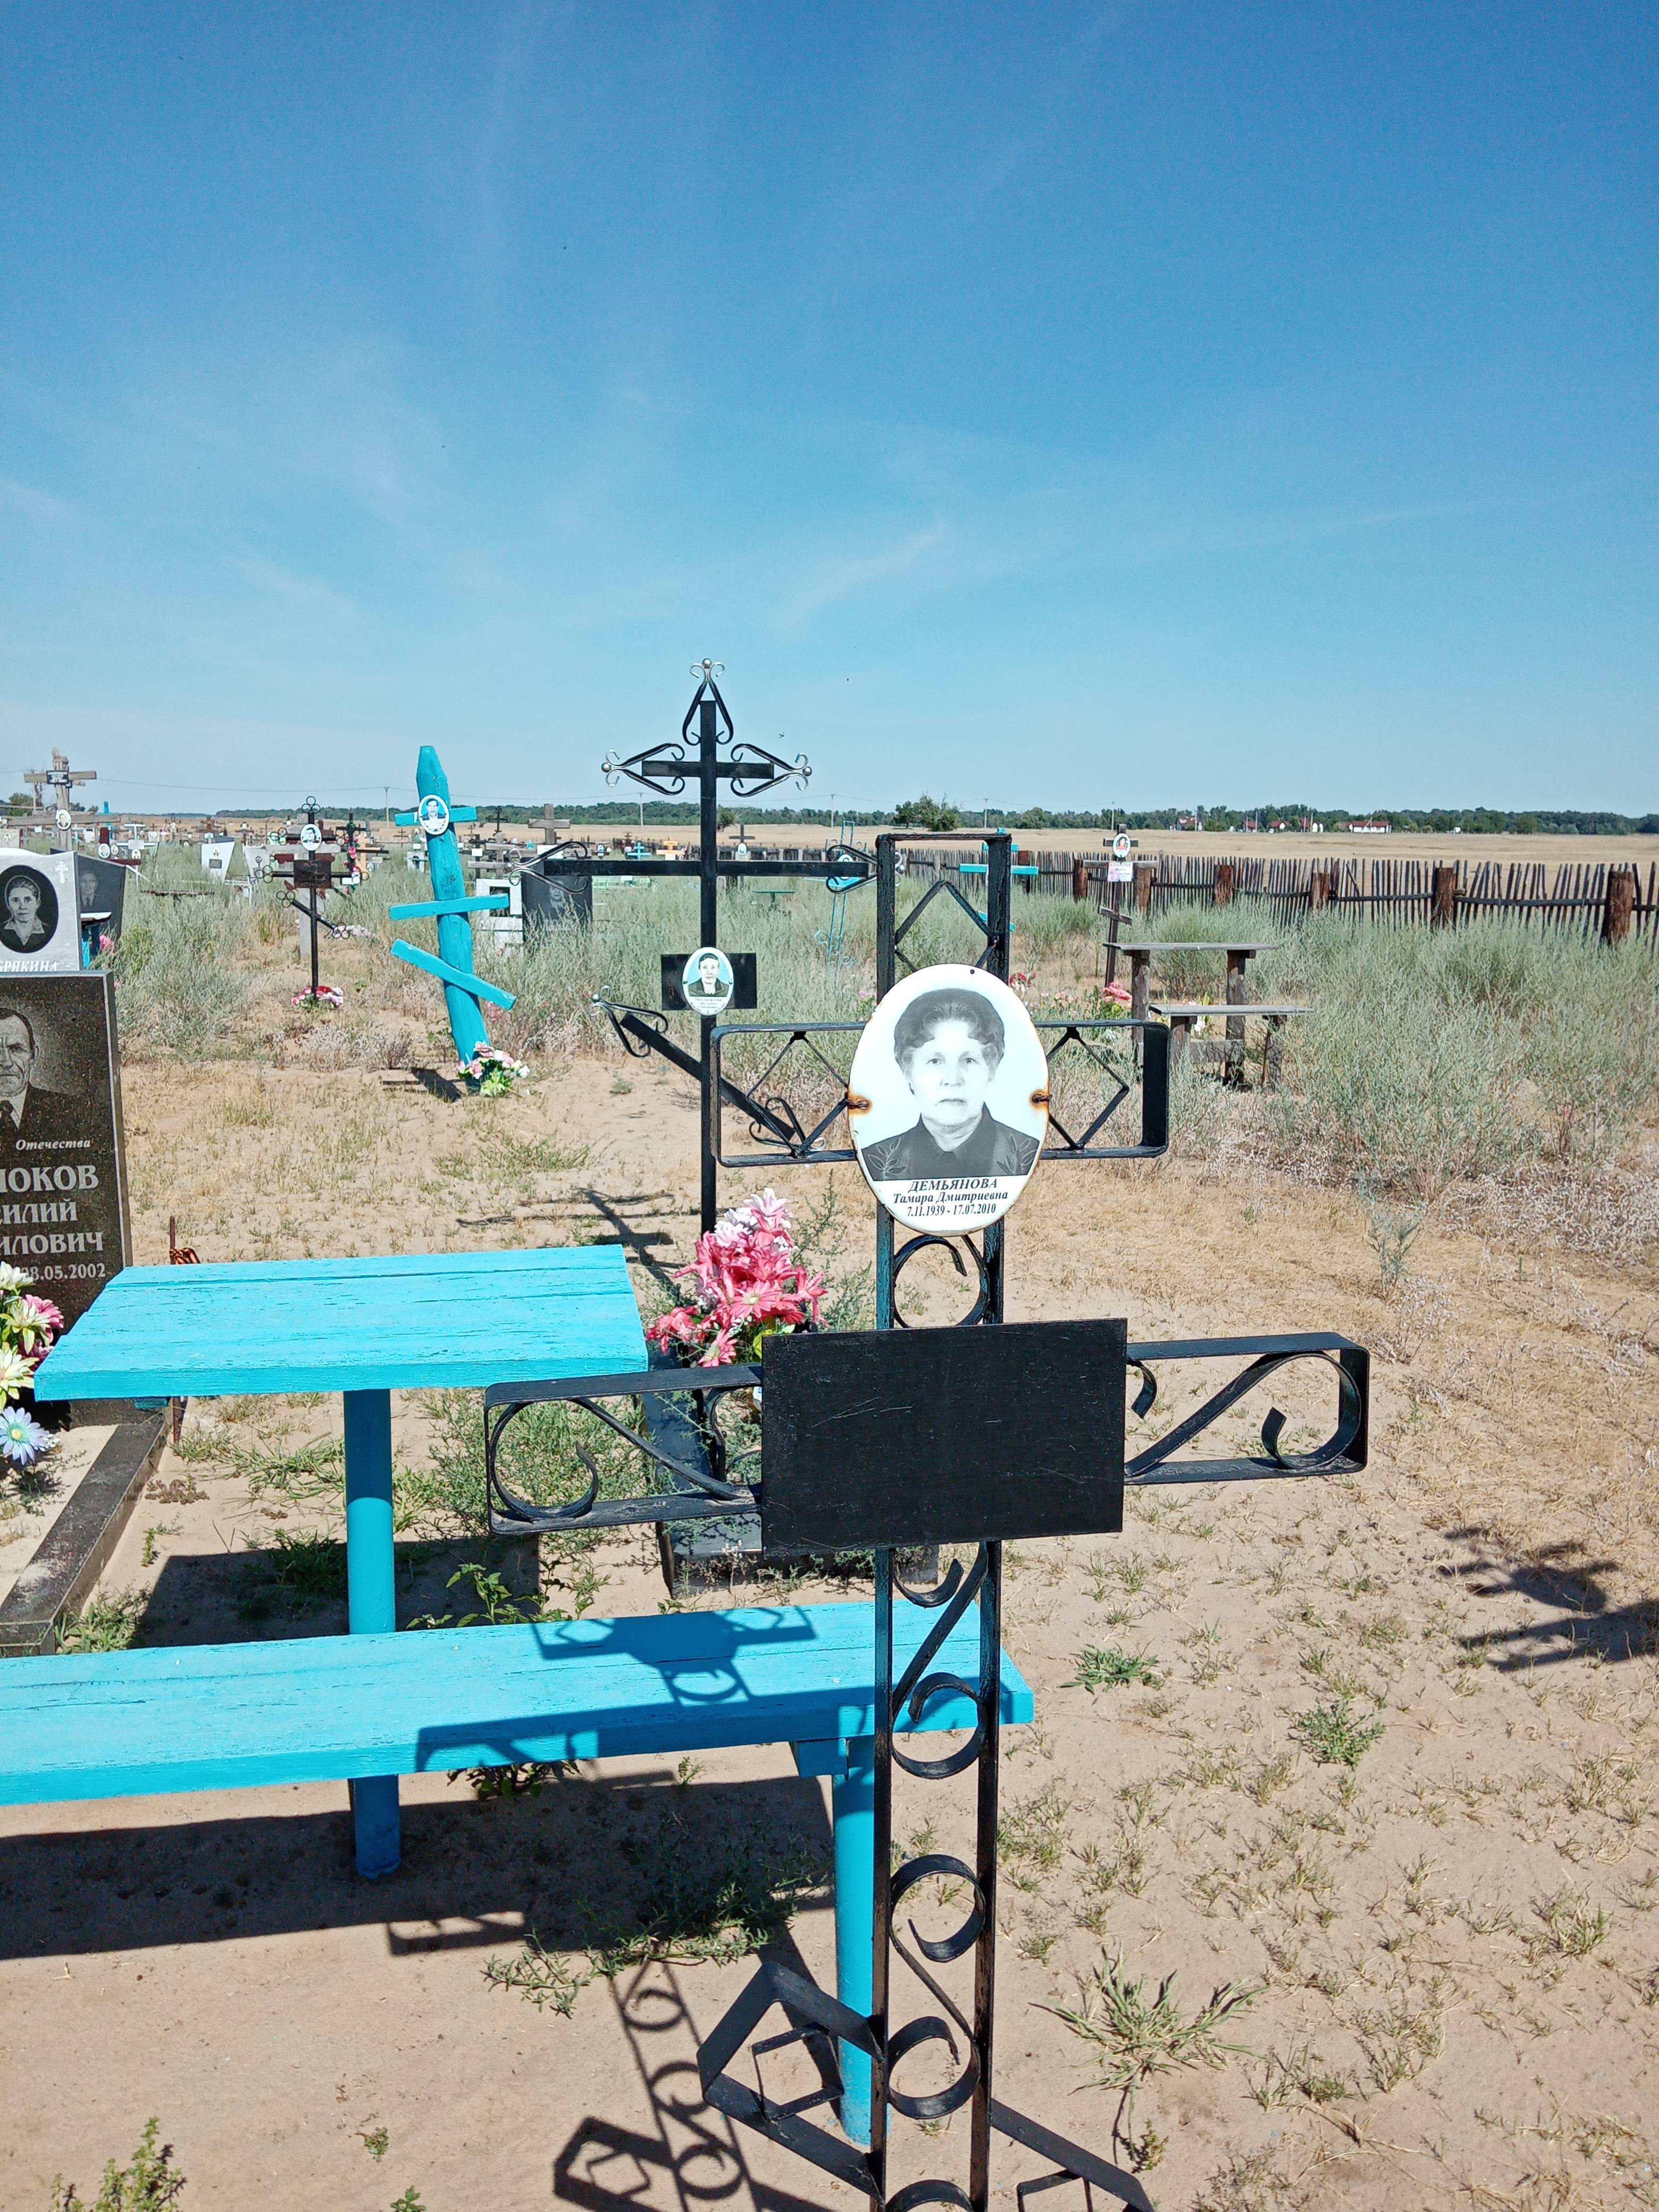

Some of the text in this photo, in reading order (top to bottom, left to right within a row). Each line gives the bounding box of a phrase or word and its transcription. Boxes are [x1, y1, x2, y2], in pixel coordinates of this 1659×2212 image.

[15, 1139, 91, 1150] Отечества
[908, 1178, 998, 1193] ДЕМЬЯНОВА
[893, 1191, 1008, 1204] Тамара Дмитриевна
[0, 1197, 78, 1225] ИЛИЙ
[907, 1206, 945, 1217] 7.11.1939
[953, 1203, 996, 1215] 17.07.2010
